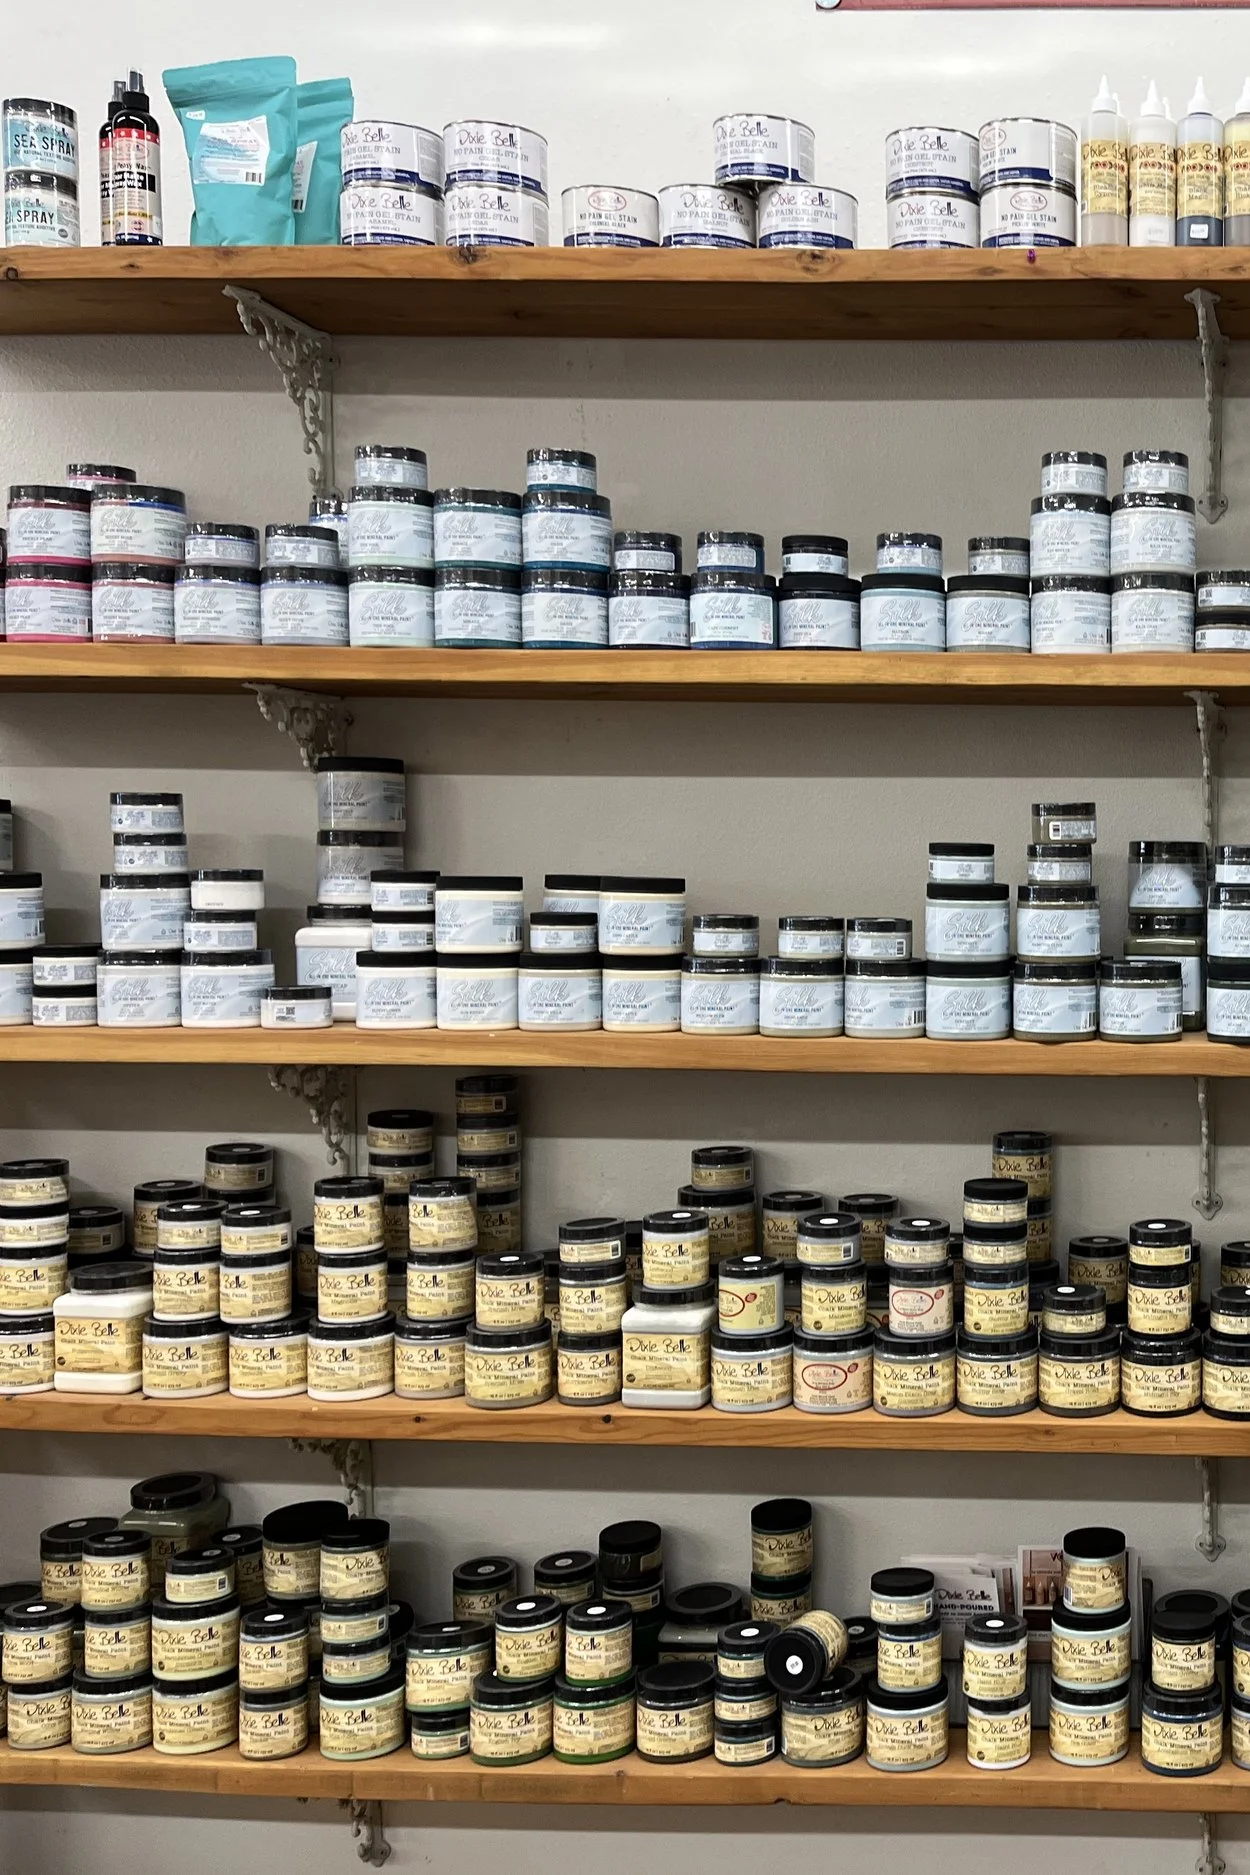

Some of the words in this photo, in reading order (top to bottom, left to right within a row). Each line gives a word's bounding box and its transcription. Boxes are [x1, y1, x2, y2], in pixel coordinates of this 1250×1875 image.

[740, 121, 769, 138] Belle
[14, 134, 37, 149] SEA
[42, 137, 75, 158] SPRAY
[459, 128, 486, 145] Dixie
[491, 130, 521, 149] Belle
[920, 134, 949, 151] Belle
[932, 155, 957, 163] STAIN
[382, 193, 413, 211] Belle
[479, 193, 511, 212] Belle
[718, 195, 744, 215] Belle
[770, 191, 797, 208] Dixie
[803, 189, 831, 208] Belle
[17, 210, 54, 225] SPRAY
[690, 210, 709, 219] PAIN
[899, 202, 926, 217] Dixie
[930, 201, 958, 218] Belle
[395, 214, 421, 224] STAIN
[493, 214, 519, 224] STAIN
[942, 220, 966, 229] STAIN
[1040, 215, 1057, 223] STAIN
[877, 599, 923, 631] Silk
[961, 600, 1008, 632] Silk
[944, 912, 989, 941] Silk
[1027, 912, 1068, 934] Silk
[451, 979, 496, 1007] Silk
[528, 979, 569, 1007] Silk
[942, 990, 988, 1020] Silk
[320, 1275, 341, 1290] Dixie
[347, 1273, 376, 1290] Belle
[57, 1320, 87, 1336] Dixie
[91, 1322, 120, 1337] Belle
[626, 1336, 660, 1352] Dixie
[663, 1339, 691, 1354] Belle
[168, 1347, 200, 1362] Belle
[477, 1356, 503, 1371] Dixie
[508, 1355, 535, 1370] Belle
[963, 1365, 987, 1379] Dixie
[991, 1364, 1018, 1380] Belle
[1132, 1368, 1160, 1383] Dixie
[1166, 1368, 1191, 1383] Belle
[935, 1589, 963, 1601] Dixie
[966, 1589, 992, 1601] Belle
[439, 1657, 468, 1674] Belle
[874, 1720, 899, 1735] Dixie
[902, 1719, 930, 1734] Belle
[1151, 1722, 1178, 1740] Dixie
[1183, 1724, 1209, 1741] Belle
